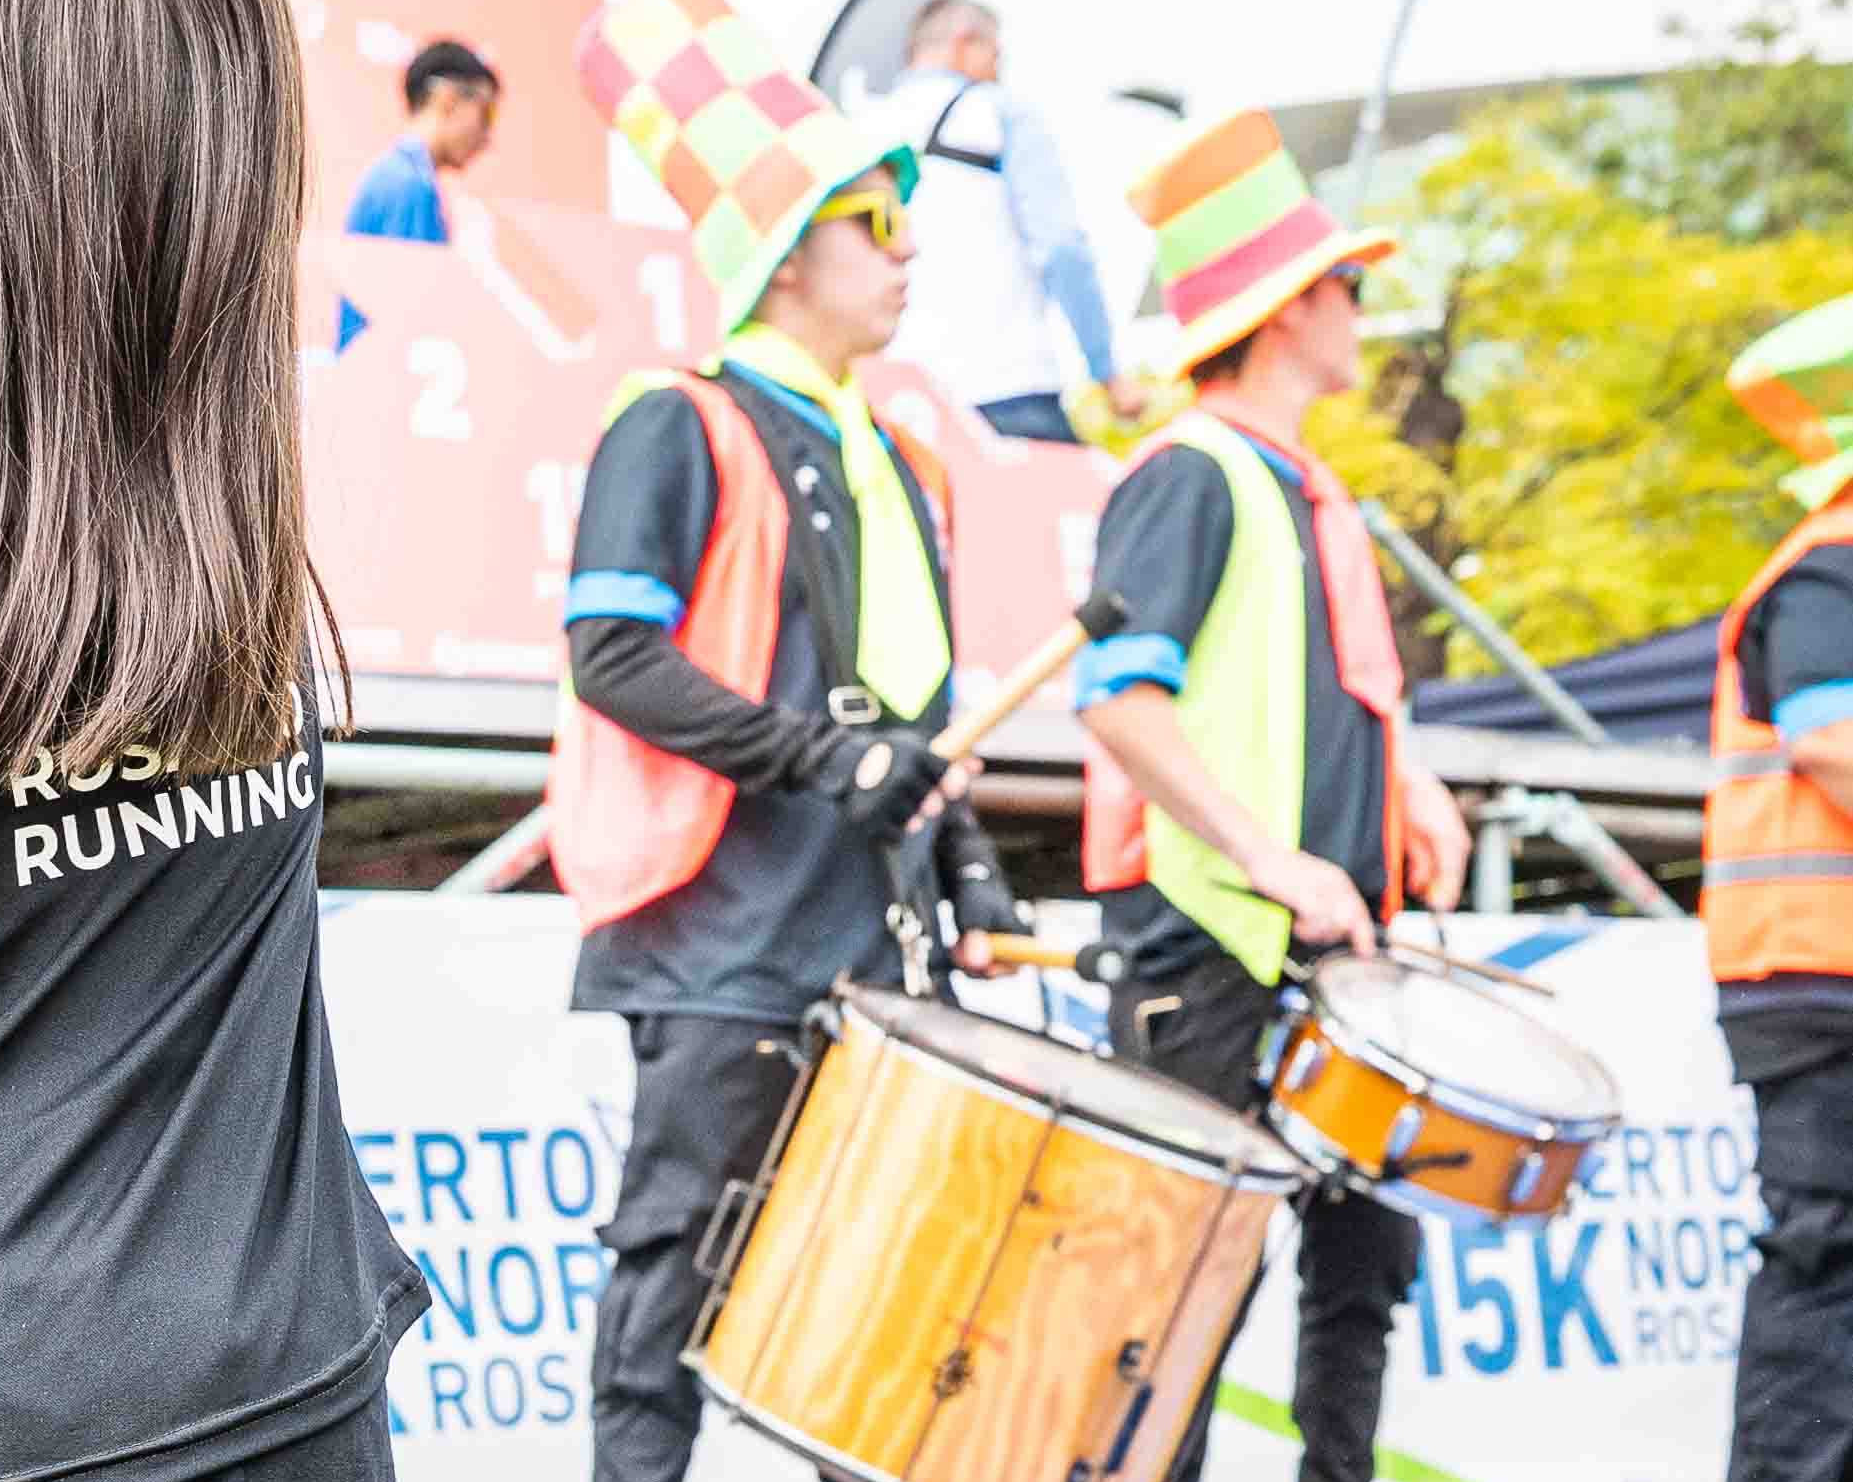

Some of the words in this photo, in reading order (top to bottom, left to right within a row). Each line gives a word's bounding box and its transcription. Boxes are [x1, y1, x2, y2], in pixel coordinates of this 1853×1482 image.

[638, 254, 685, 352] 1
[407, 336, 473, 440] 2
[13, 750, 316, 887] RUNNING
[354, 1128, 597, 1224] ERTO
[416, 1245, 614, 1342] NOR
